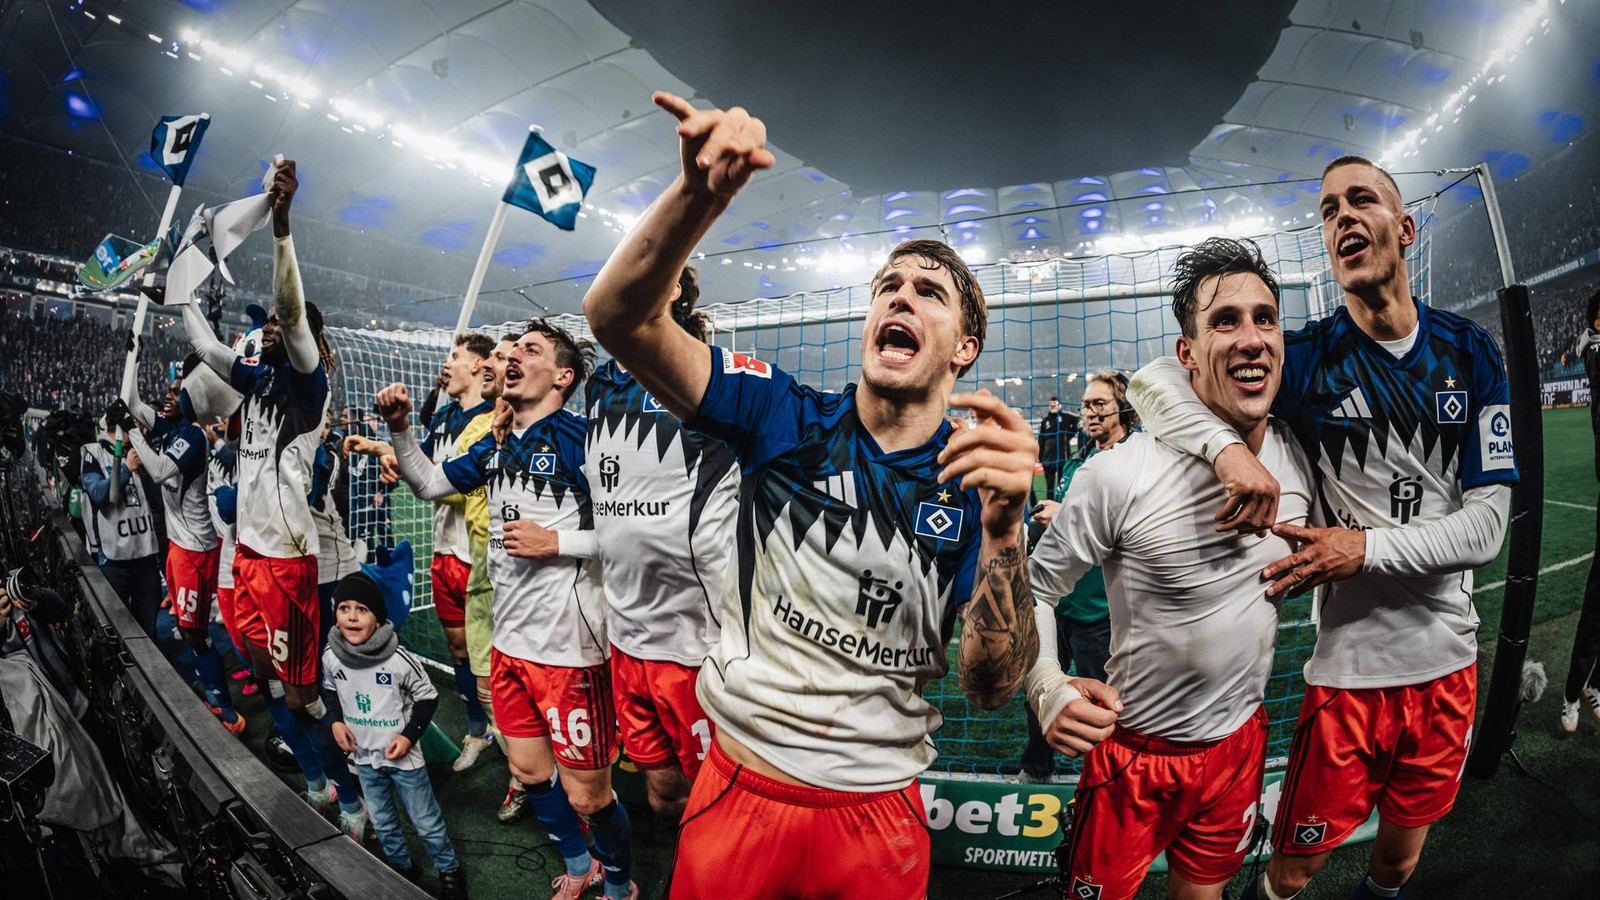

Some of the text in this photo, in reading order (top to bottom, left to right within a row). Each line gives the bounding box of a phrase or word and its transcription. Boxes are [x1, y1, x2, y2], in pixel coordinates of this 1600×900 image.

[594, 499, 670, 517] seMerkur
[177, 586, 198, 613] 45
[773, 594, 935, 668] HanseMerkur
[546, 706, 592, 747] 16
[919, 783, 1076, 838] bet3
[964, 847, 1057, 868] SPORTWETT
